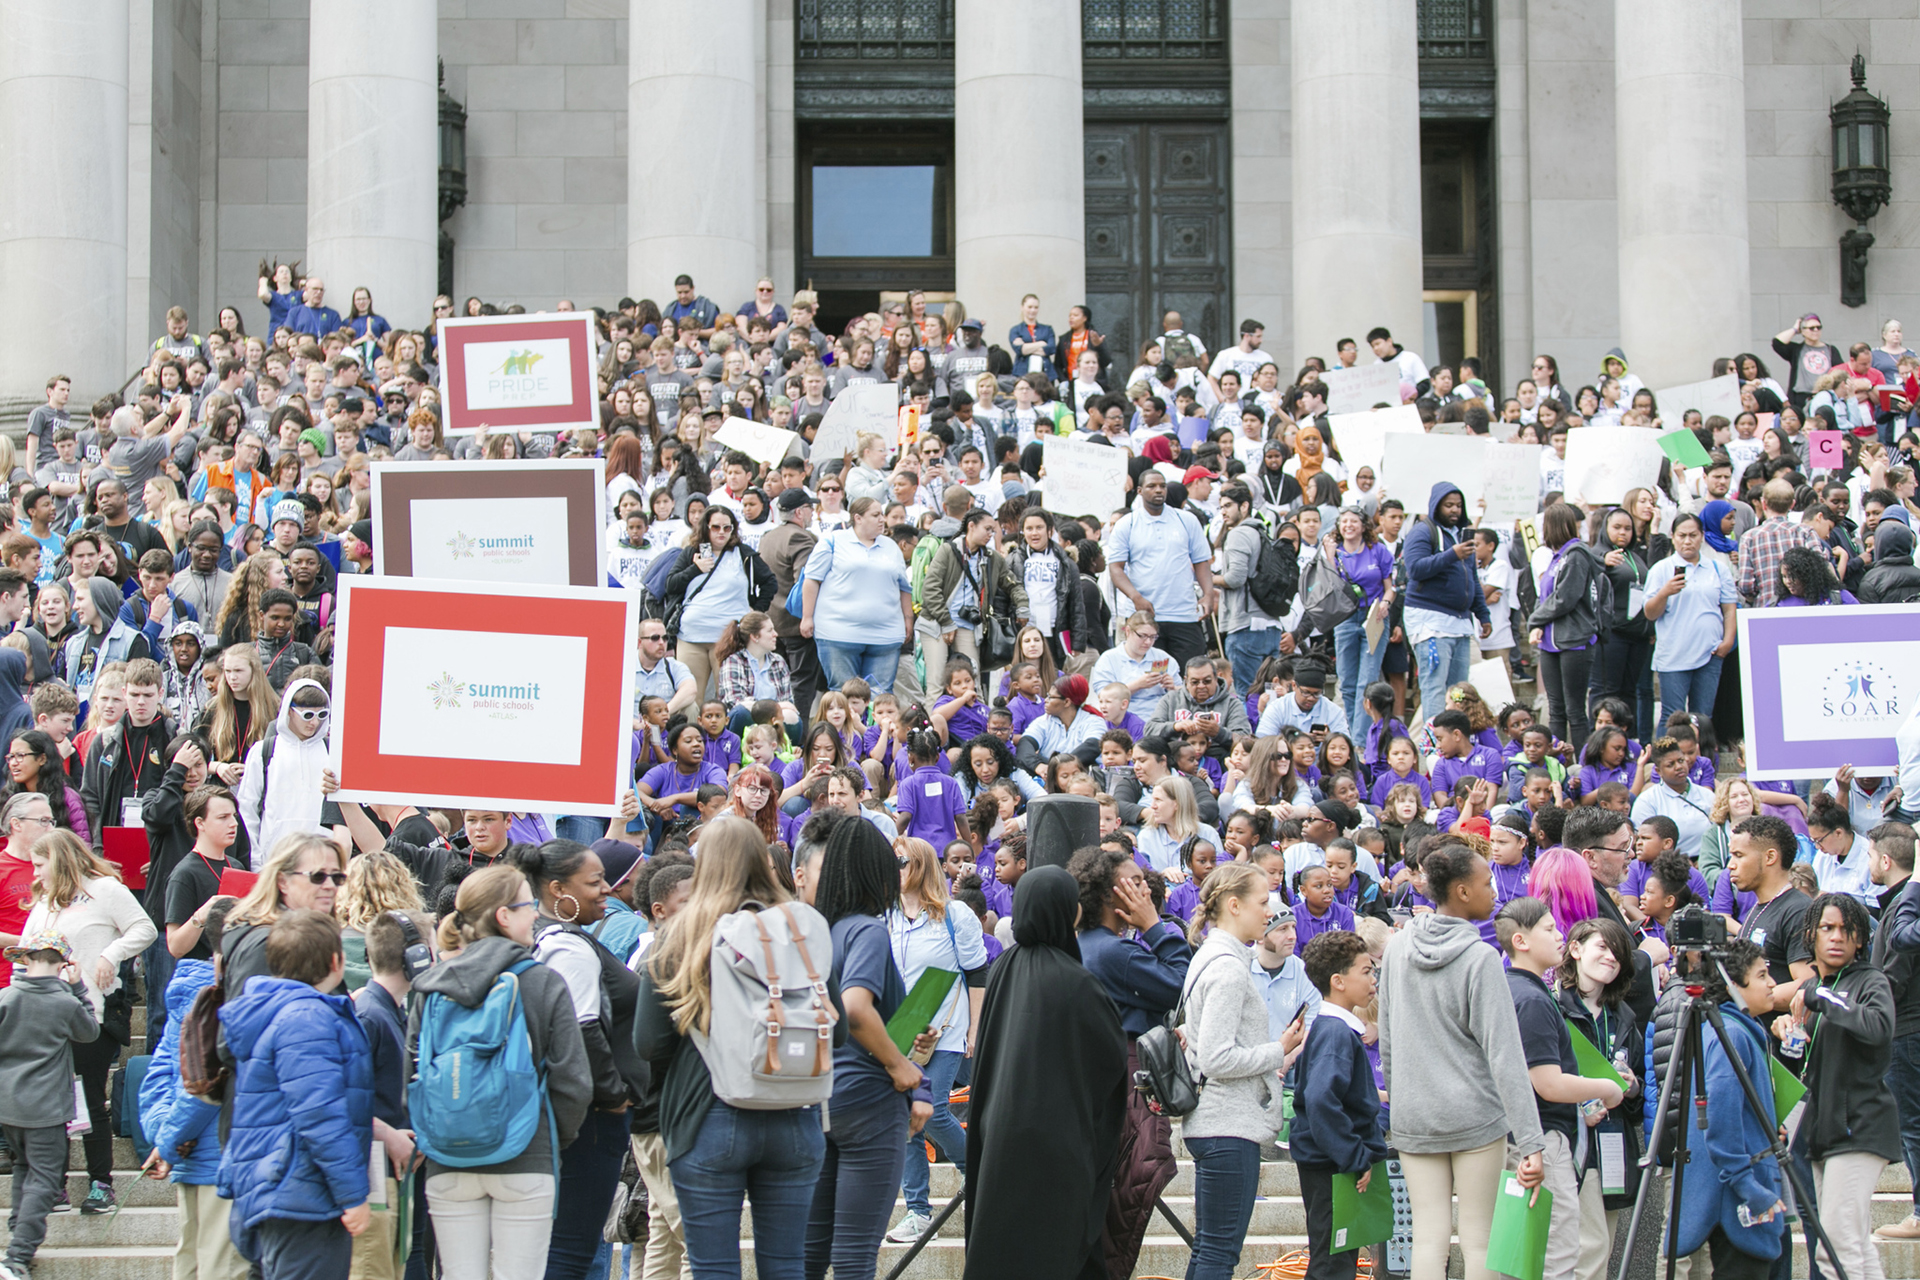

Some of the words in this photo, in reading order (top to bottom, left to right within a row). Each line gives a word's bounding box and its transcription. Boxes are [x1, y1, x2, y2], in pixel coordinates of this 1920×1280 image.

[489, 377, 550, 393] PRIDE
[503, 392, 537, 401] PREP
[1820, 440, 1833, 453] C
[479, 534, 535, 549] summit
[1524, 524, 1540, 552] B
[483, 549, 504, 557] public
[469, 682, 540, 700] summit
[473, 699, 500, 709] public
[502, 701, 534, 711] schools
[1823, 701, 1900, 717] SOAR
[491, 712, 514, 720] ATLAS
[452, 1052, 461, 1099] patagonia
